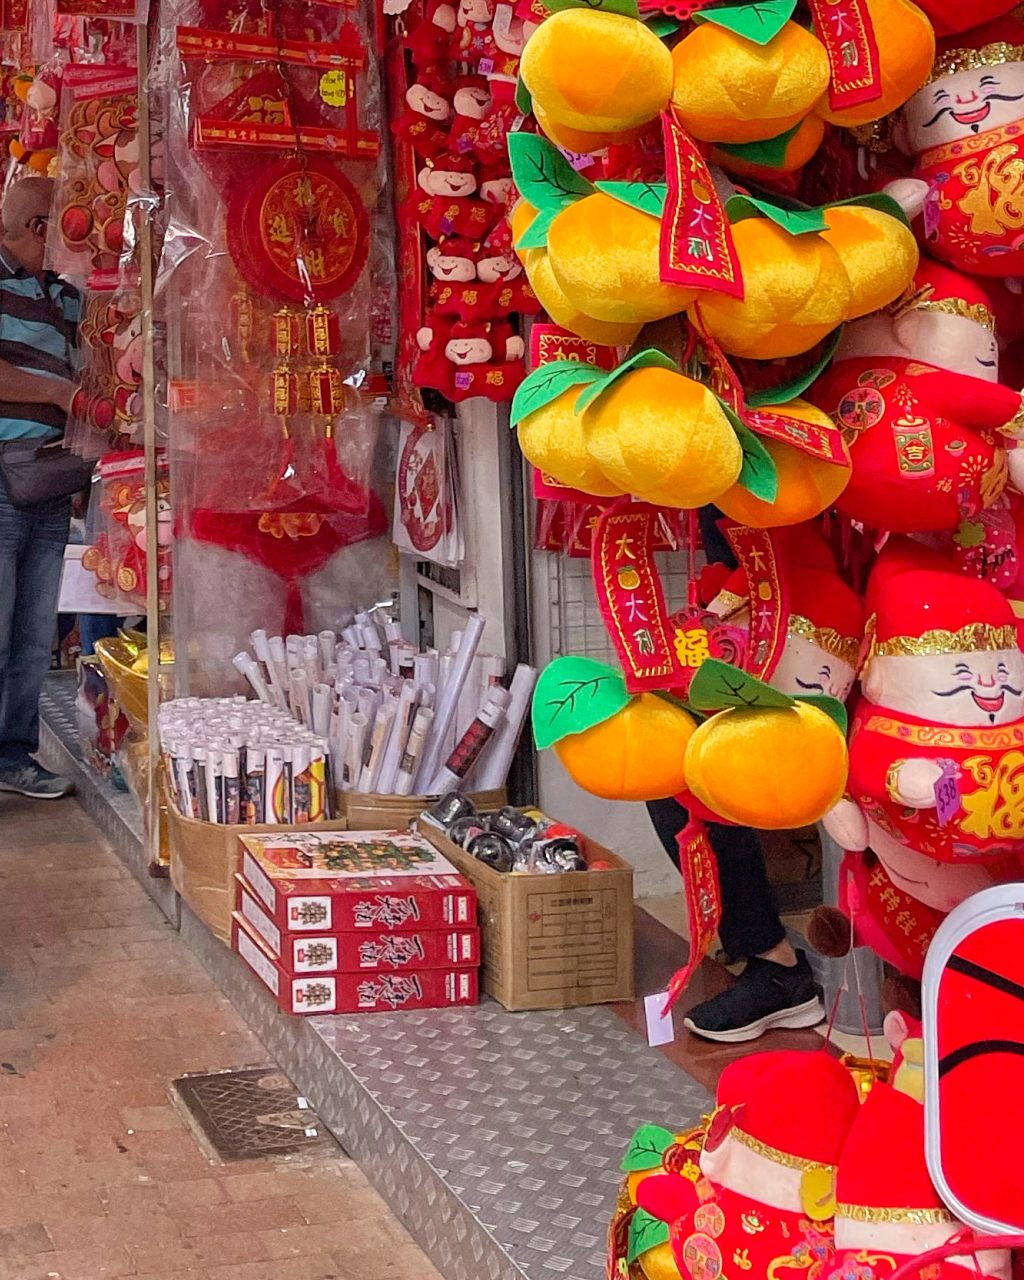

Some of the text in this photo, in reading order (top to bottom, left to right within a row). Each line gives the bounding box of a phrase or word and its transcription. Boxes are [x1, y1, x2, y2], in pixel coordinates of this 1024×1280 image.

[906, 446, 925, 461] 吉
[673, 627, 711, 667] 福
[937, 776, 958, 813] $38
